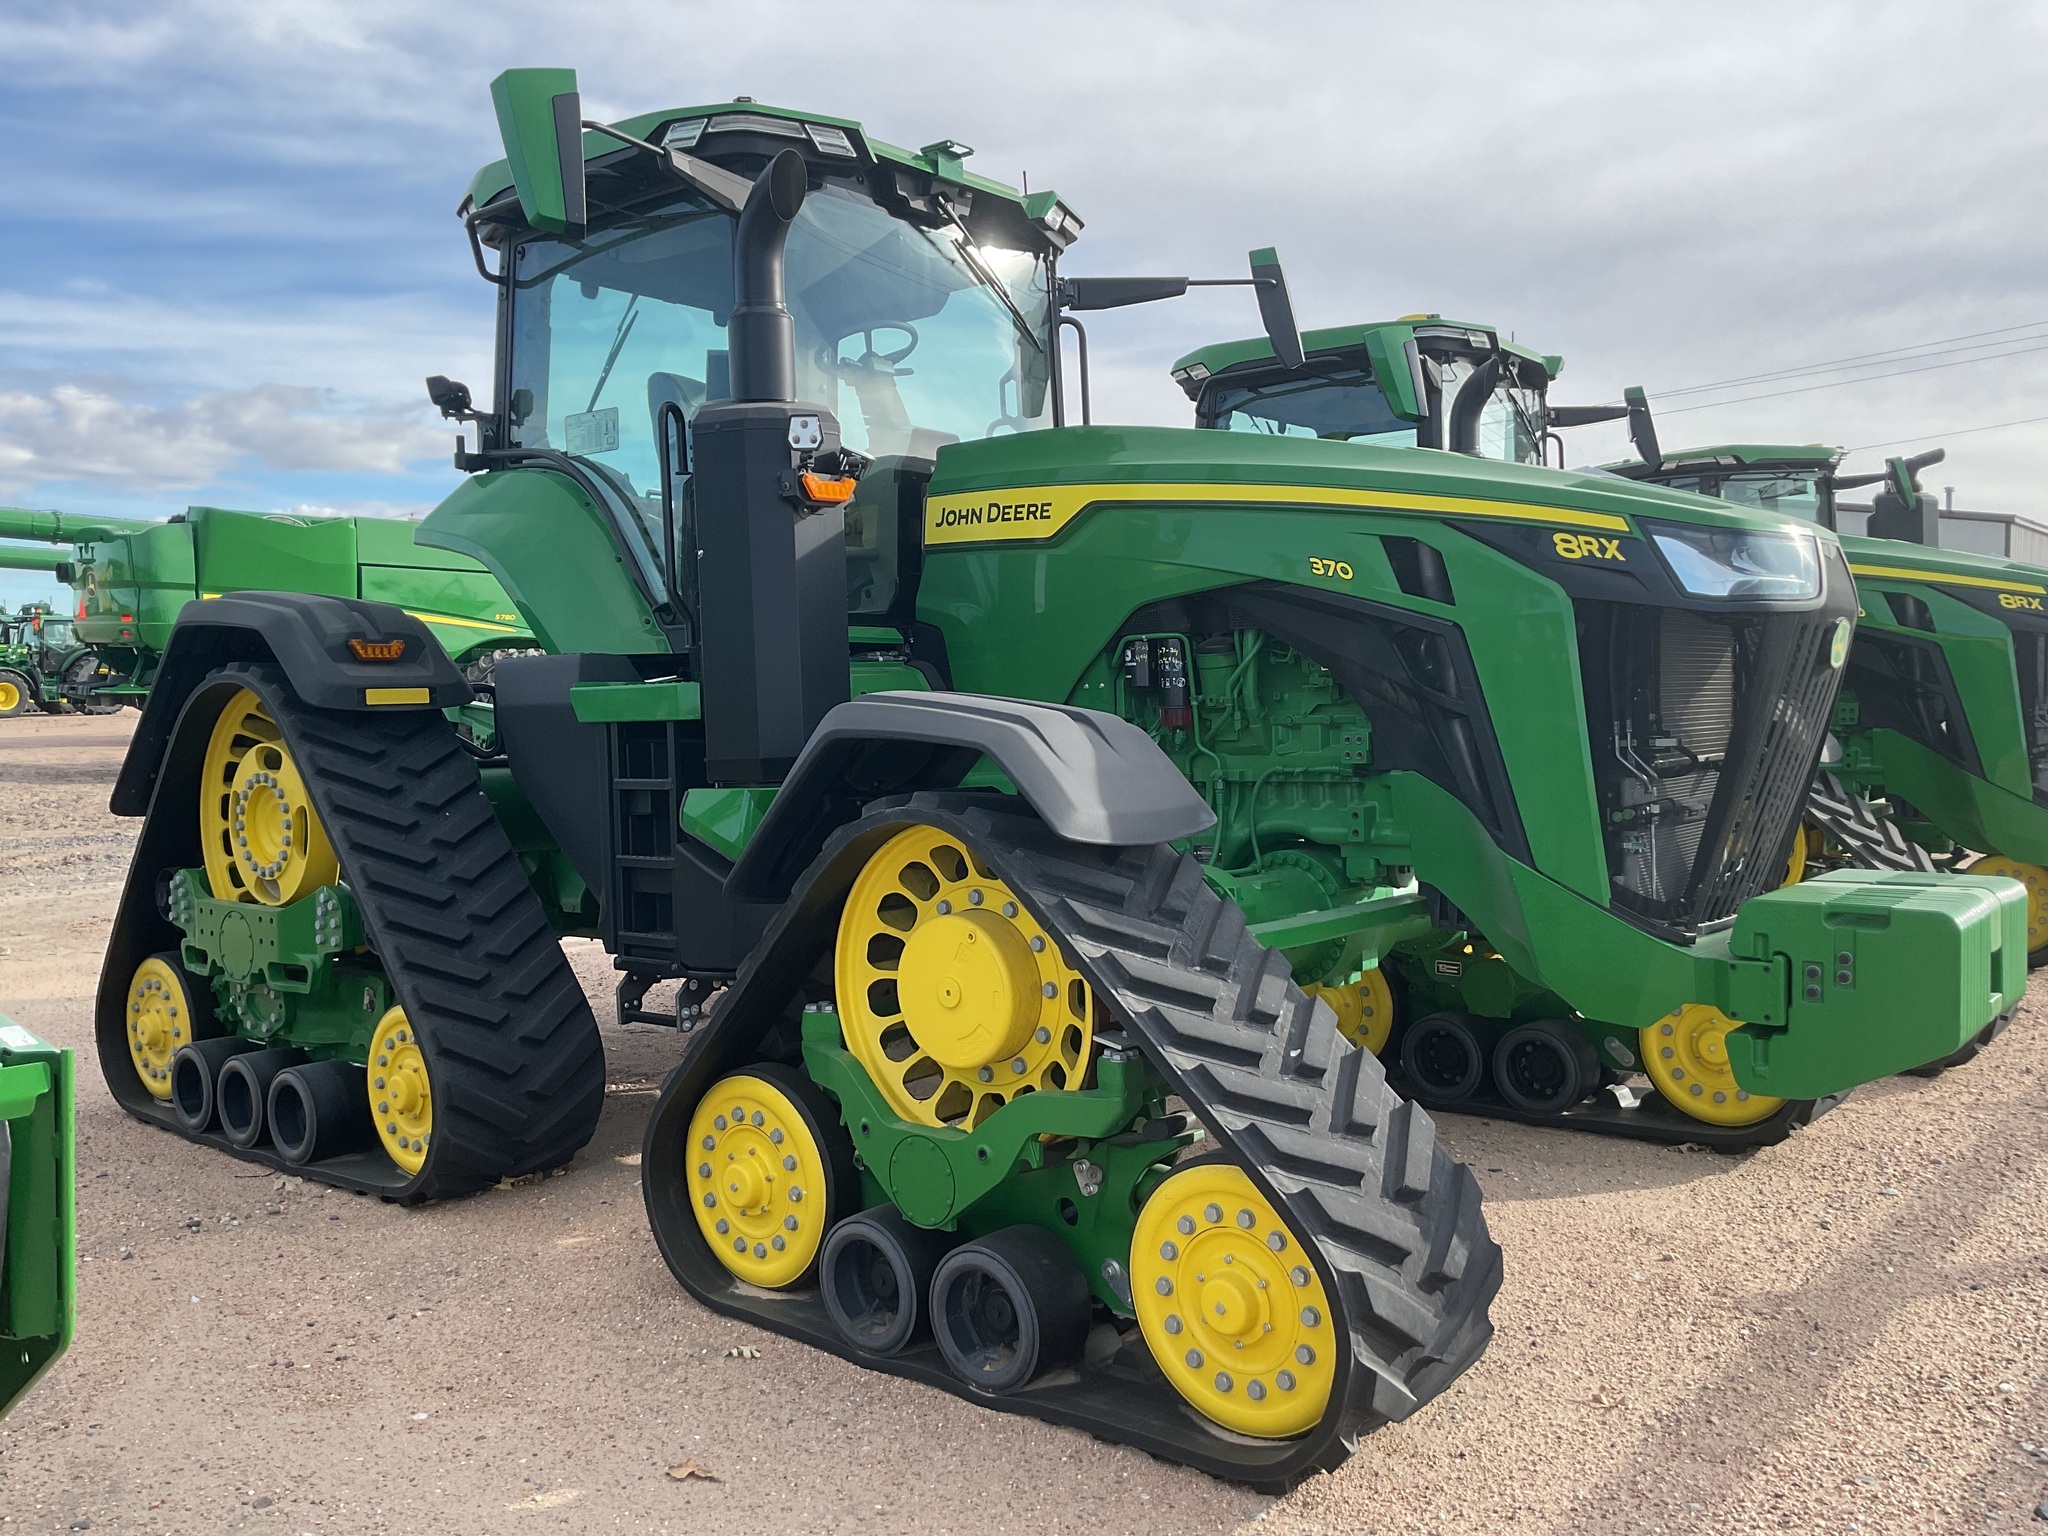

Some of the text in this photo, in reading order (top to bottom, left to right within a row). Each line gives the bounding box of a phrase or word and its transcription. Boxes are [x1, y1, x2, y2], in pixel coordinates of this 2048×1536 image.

[935, 502, 1053, 528] JOHN DEERE
[1552, 532, 1627, 562] 8RX
[1308, 556, 1355, 580] 370
[1998, 593, 2045, 612] 8RX
